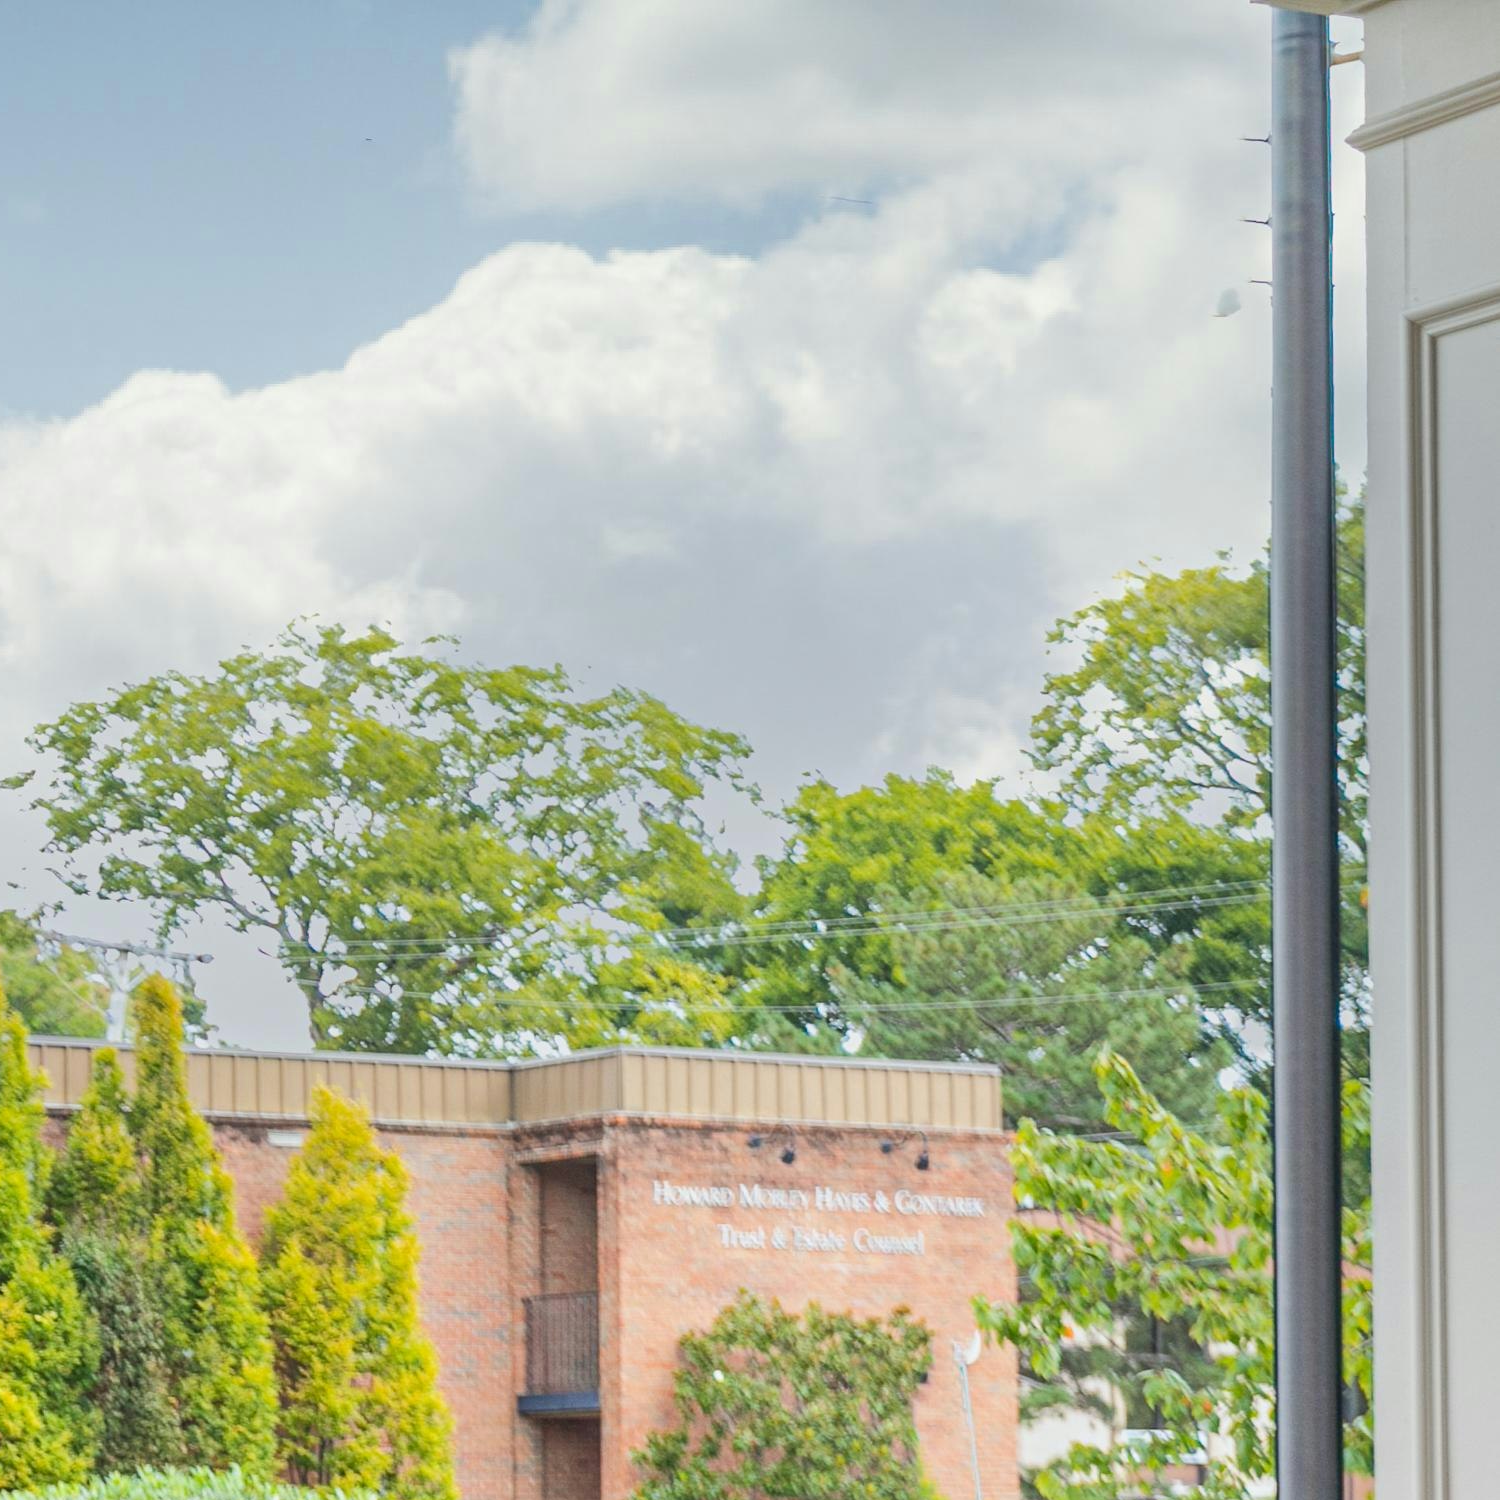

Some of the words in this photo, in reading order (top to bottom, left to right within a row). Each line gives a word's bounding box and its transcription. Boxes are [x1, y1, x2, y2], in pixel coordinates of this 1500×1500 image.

[873, 1190, 890, 1213] &
[717, 1223, 765, 1249] Trust
[771, 1227, 787, 1249] &
[792, 1226, 845, 1252] Estate
[853, 1227, 926, 1255] Counsel
